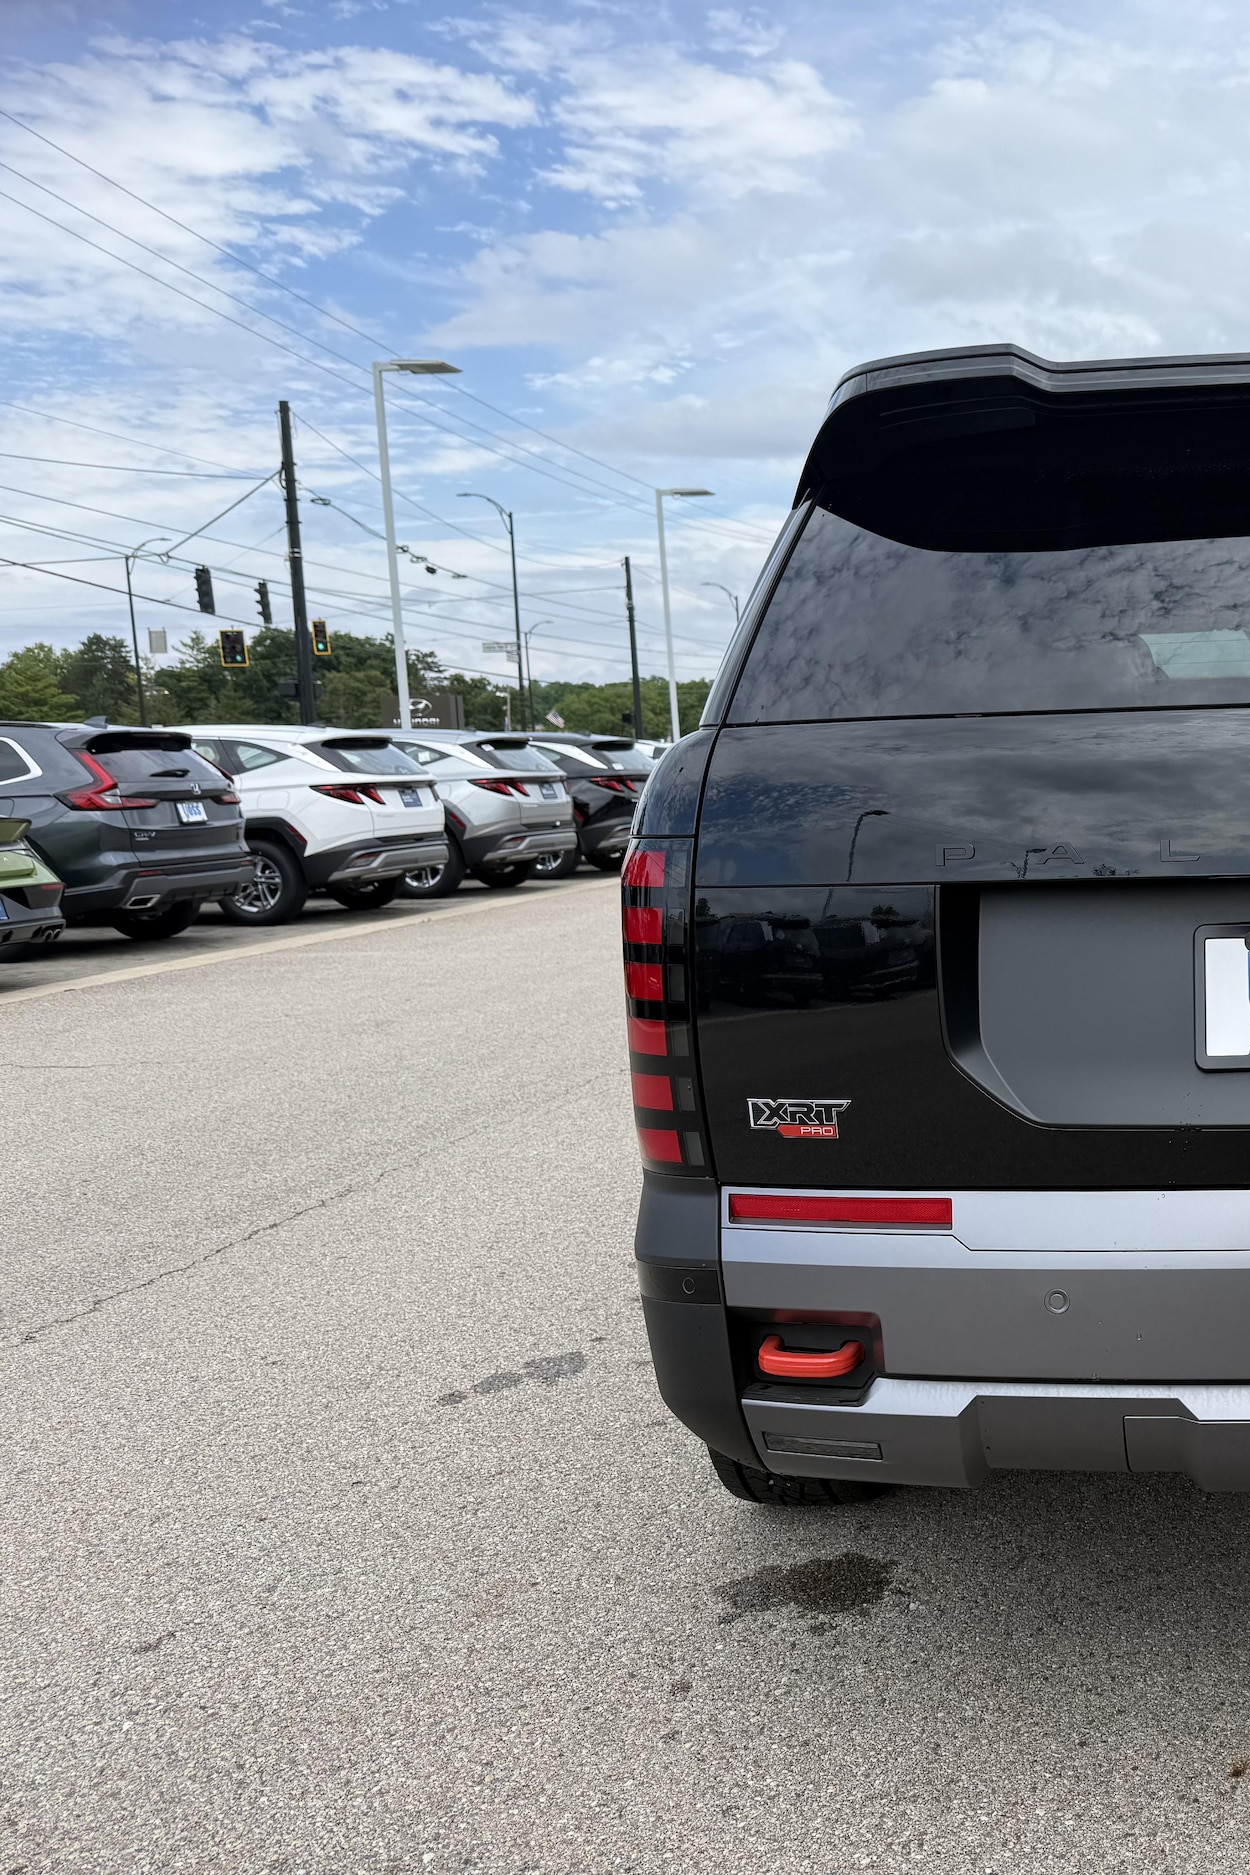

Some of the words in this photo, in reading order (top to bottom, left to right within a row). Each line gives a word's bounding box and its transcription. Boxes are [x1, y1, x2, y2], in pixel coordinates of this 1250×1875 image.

[393, 717, 440, 726] HNDAI
[755, 1099, 850, 1125] XRT
[800, 1126, 834, 1135] PRO
